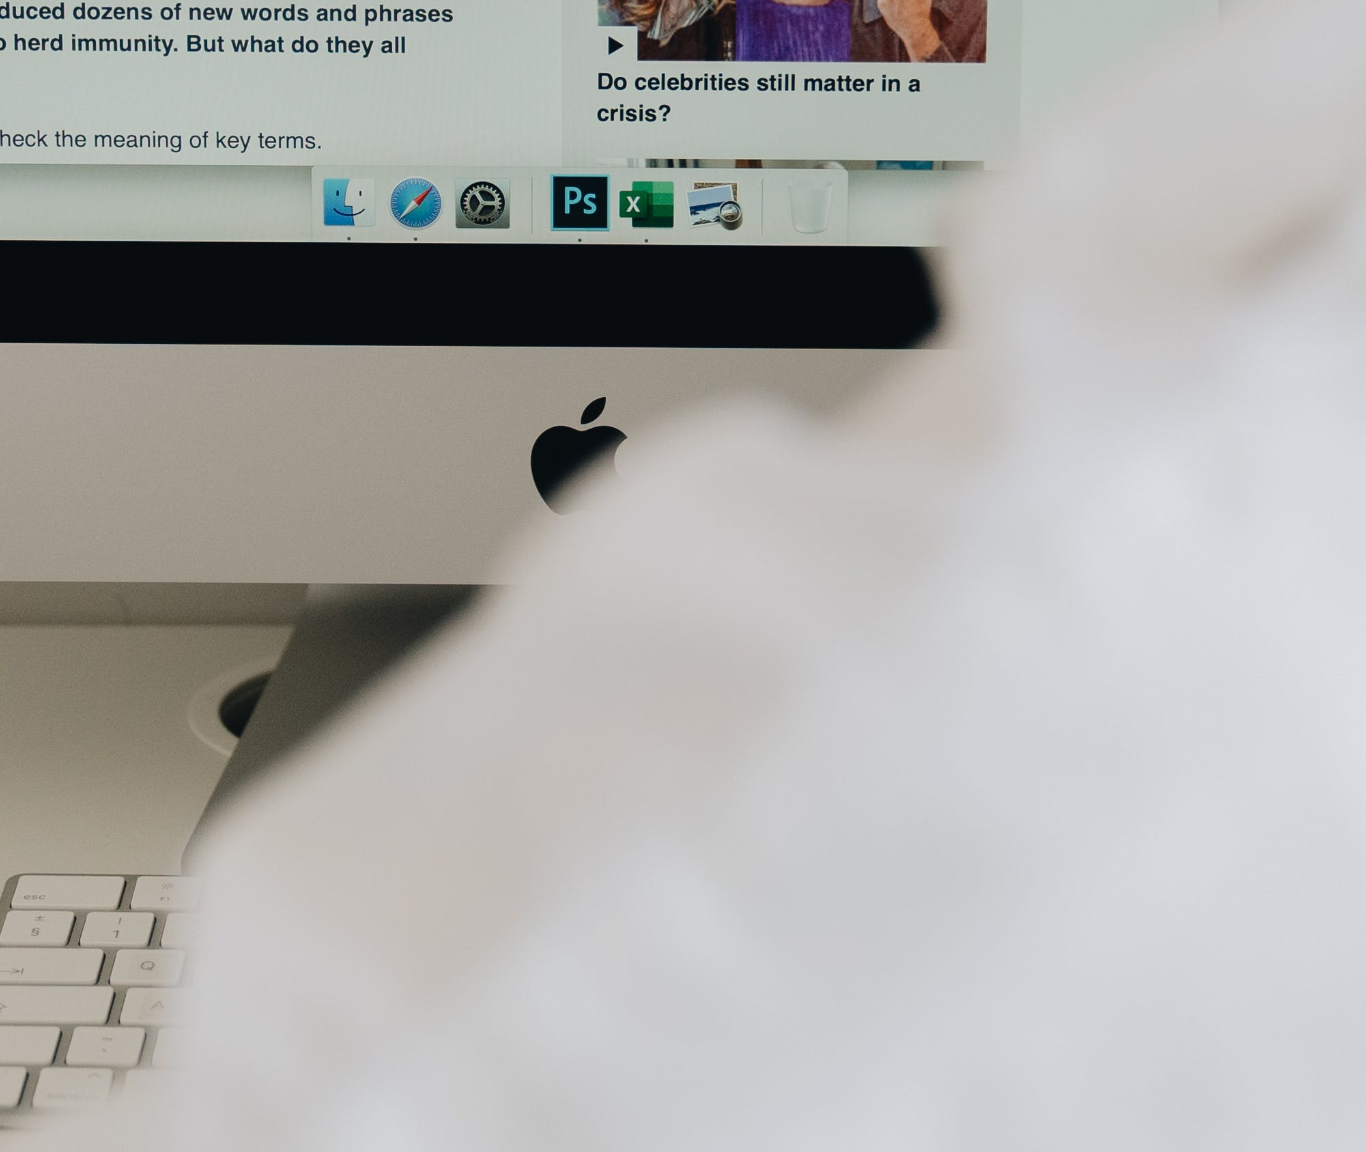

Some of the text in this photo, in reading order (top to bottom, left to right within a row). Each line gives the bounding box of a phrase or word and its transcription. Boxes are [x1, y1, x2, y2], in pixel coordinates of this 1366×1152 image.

[73, 3, 152, 20] dozens
[161, 3, 181, 20] of
[189, 7, 233, 20] new
[241, 4, 308, 21] words
[317, 5, 356, 21] and
[365, 5, 453, 26] phrases
[14, 34, 63, 51] herd
[72, 34, 177, 56] immunity.
[187, 35, 224, 52] But
[231, 35, 284, 52] what
[292, 36, 318, 53] do
[326, 36, 373, 58] they
[381, 36, 405, 53] all
[598, 73, 920, 92] Do celebrities still matter in a
[597, 104, 670, 122] crisis?
[55, 130, 86, 147] the
[95, 131, 181, 152] meaning
[190, 131, 208, 148] of
[217, 131, 251, 153] key
[258, 133, 321, 149] terms.
[564, 187, 597, 215] Ps
[141, 960, 155, 971] Q
[151, 1000, 165, 1010] A
